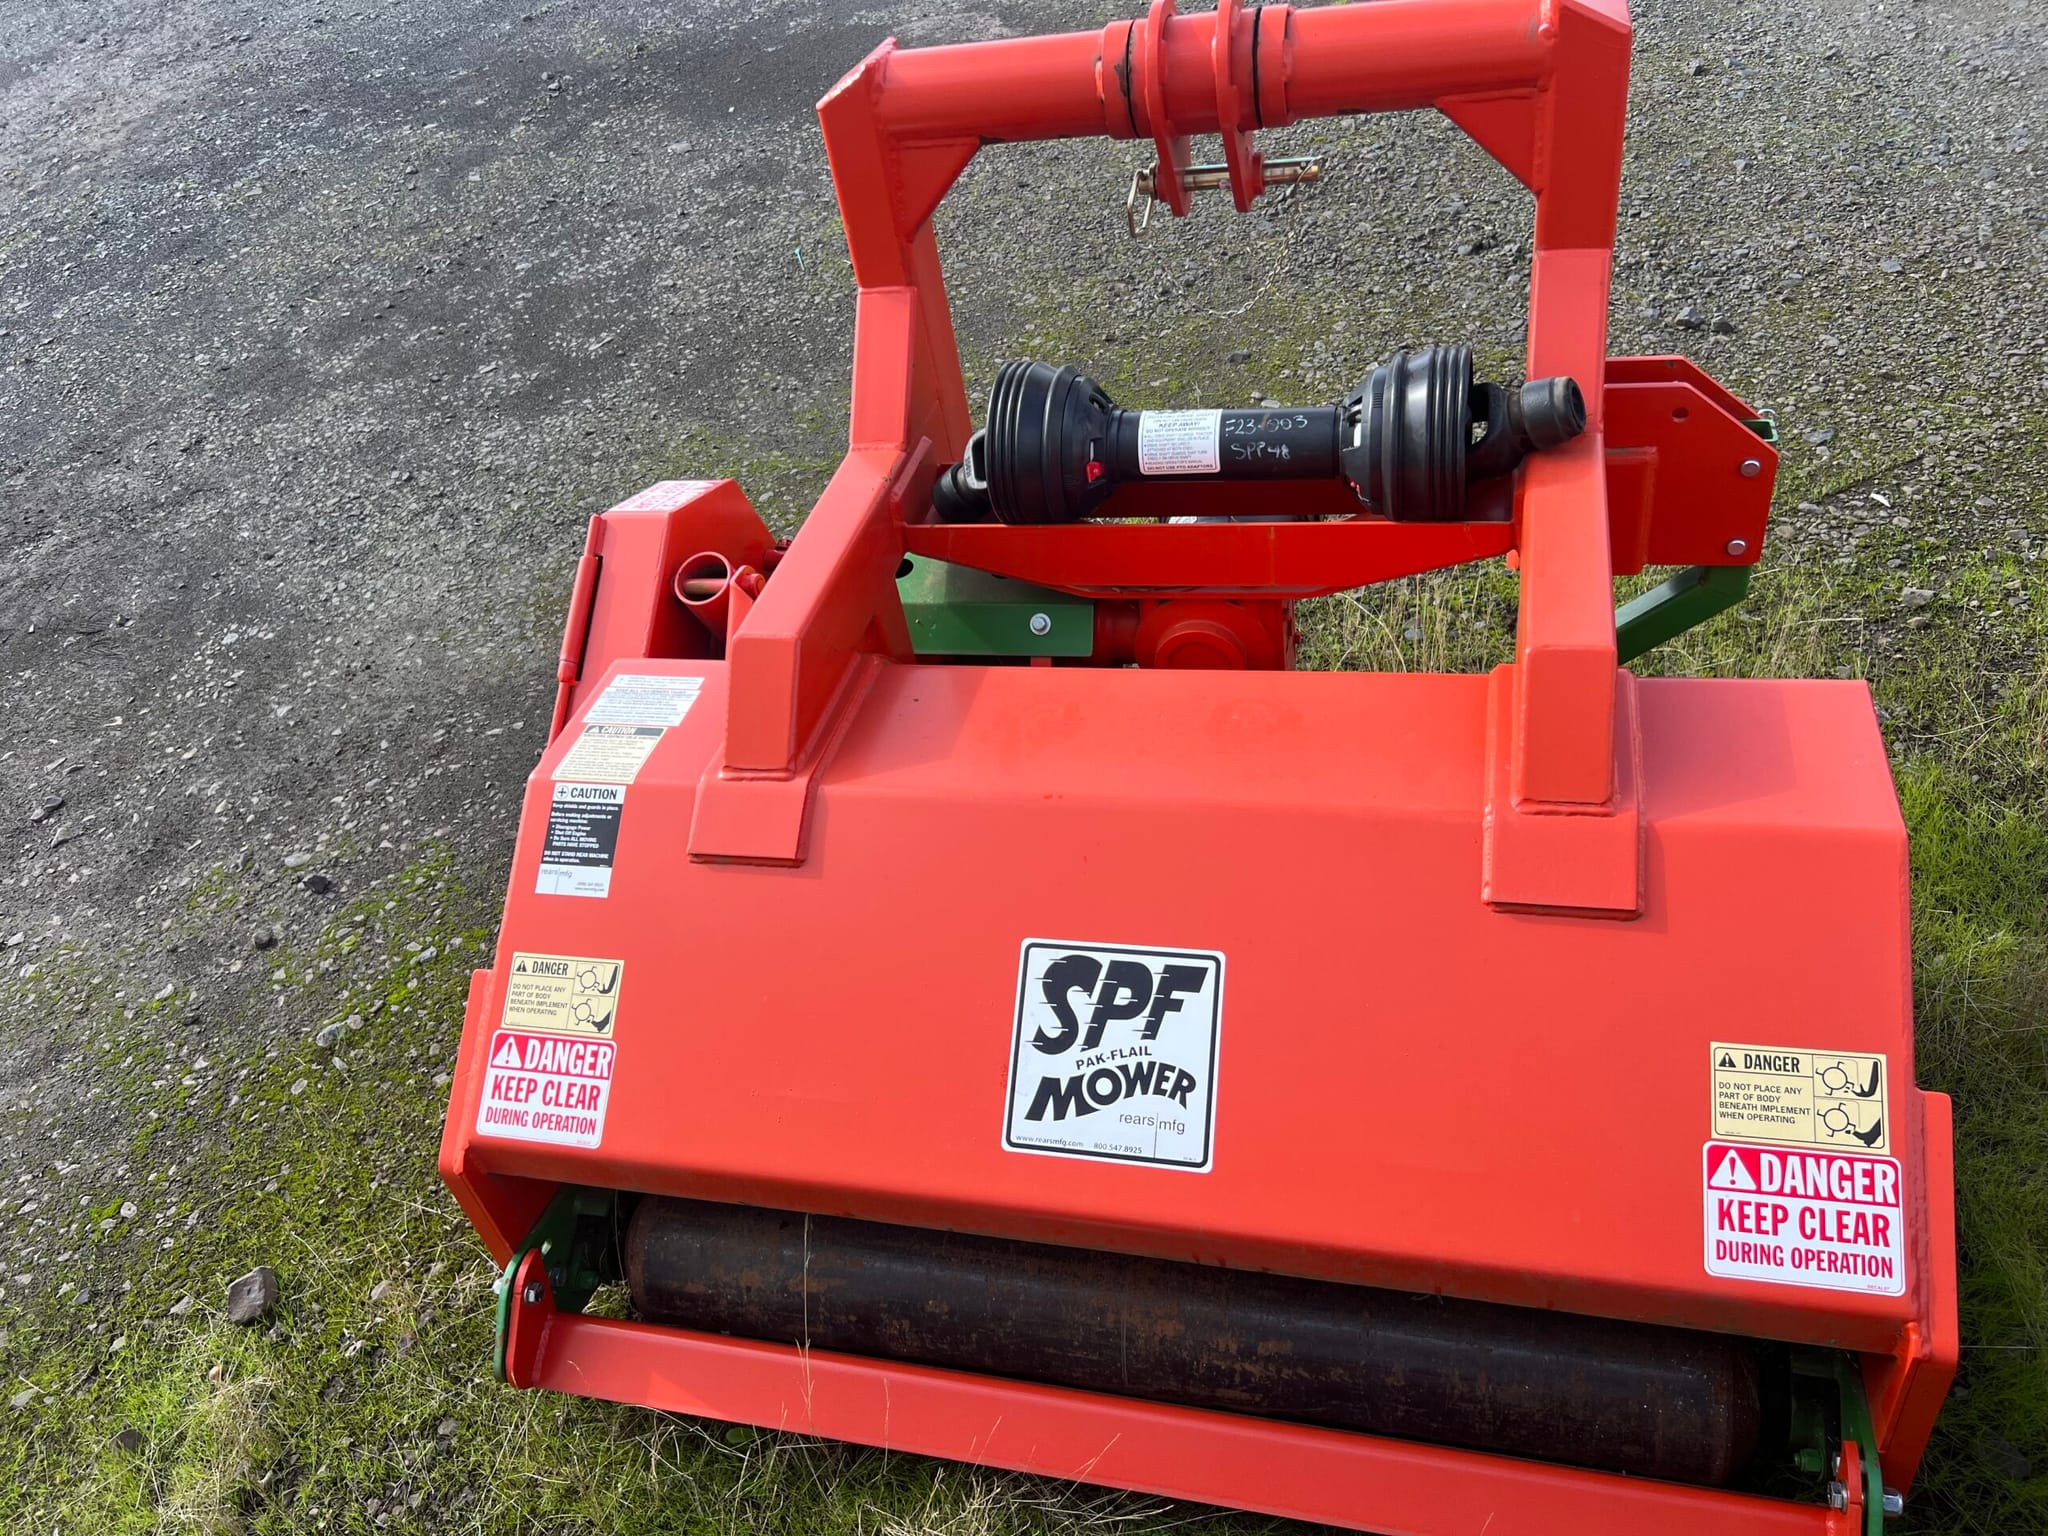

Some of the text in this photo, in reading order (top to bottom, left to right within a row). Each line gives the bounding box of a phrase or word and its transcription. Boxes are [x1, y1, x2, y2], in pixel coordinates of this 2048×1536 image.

[601, 726, 637, 735] CAUTION
[571, 787, 617, 800] CAUTION
[532, 961, 568, 976] DANGER
[1025, 954, 1209, 1055] SPF
[524, 1039, 613, 1078] DANGER
[1076, 1046, 1152, 1071] PAK-FLAIL
[1744, 1054, 1800, 1073] DANGER
[491, 1075, 601, 1111] KEEP CLEAR
[1024, 1061, 1197, 1121] MOWER
[1719, 1092, 1740, 1100] PART
[1757, 1095, 1781, 1103] BODY
[1734, 1083, 1751, 1091] NOT
[1754, 1085, 1781, 1093] PLACE
[1784, 1087, 1802, 1095] ANY
[1719, 1102, 1811, 1115] BENEATH IMPLEMENT
[1719, 1111, 1796, 1124] WHEN OPERATING
[485, 1107, 597, 1136] DURING OPERATION
[1119, 1113, 1185, 1135] rears mfg
[1015, 1135, 1142, 1154] www.rearsmfg.com 800.547.8925
[1760, 1152, 1896, 1204] DANGER
[1717, 1198, 1890, 1247] KEEP CLEAR
[1715, 1240, 1893, 1279] DURING OPERATION
